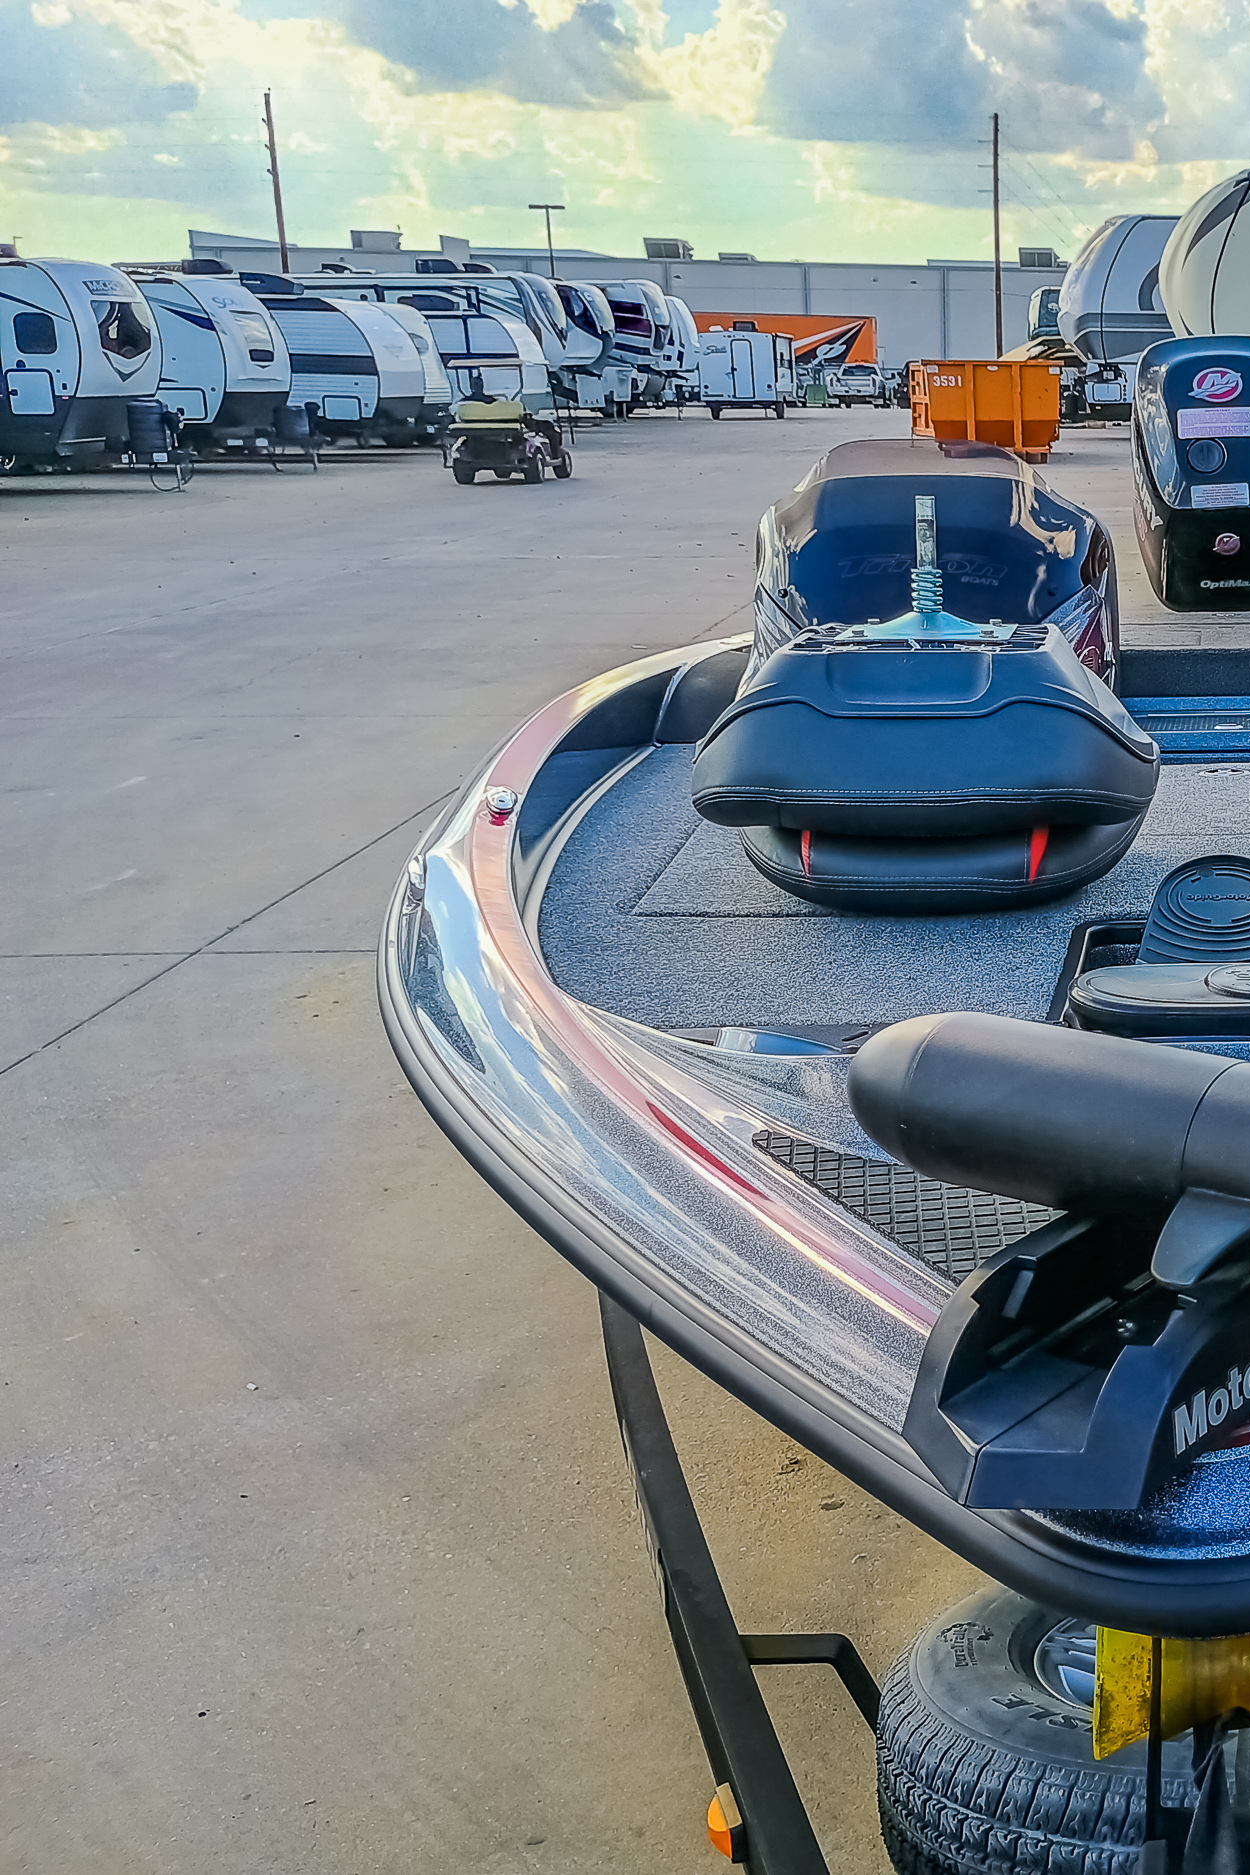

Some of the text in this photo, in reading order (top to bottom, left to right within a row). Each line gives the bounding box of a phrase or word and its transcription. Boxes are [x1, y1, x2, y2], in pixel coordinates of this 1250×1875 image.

[933, 375, 962, 387] 3531
[838, 554, 1007, 578] Trion
[960, 576, 999, 586] BOATS
